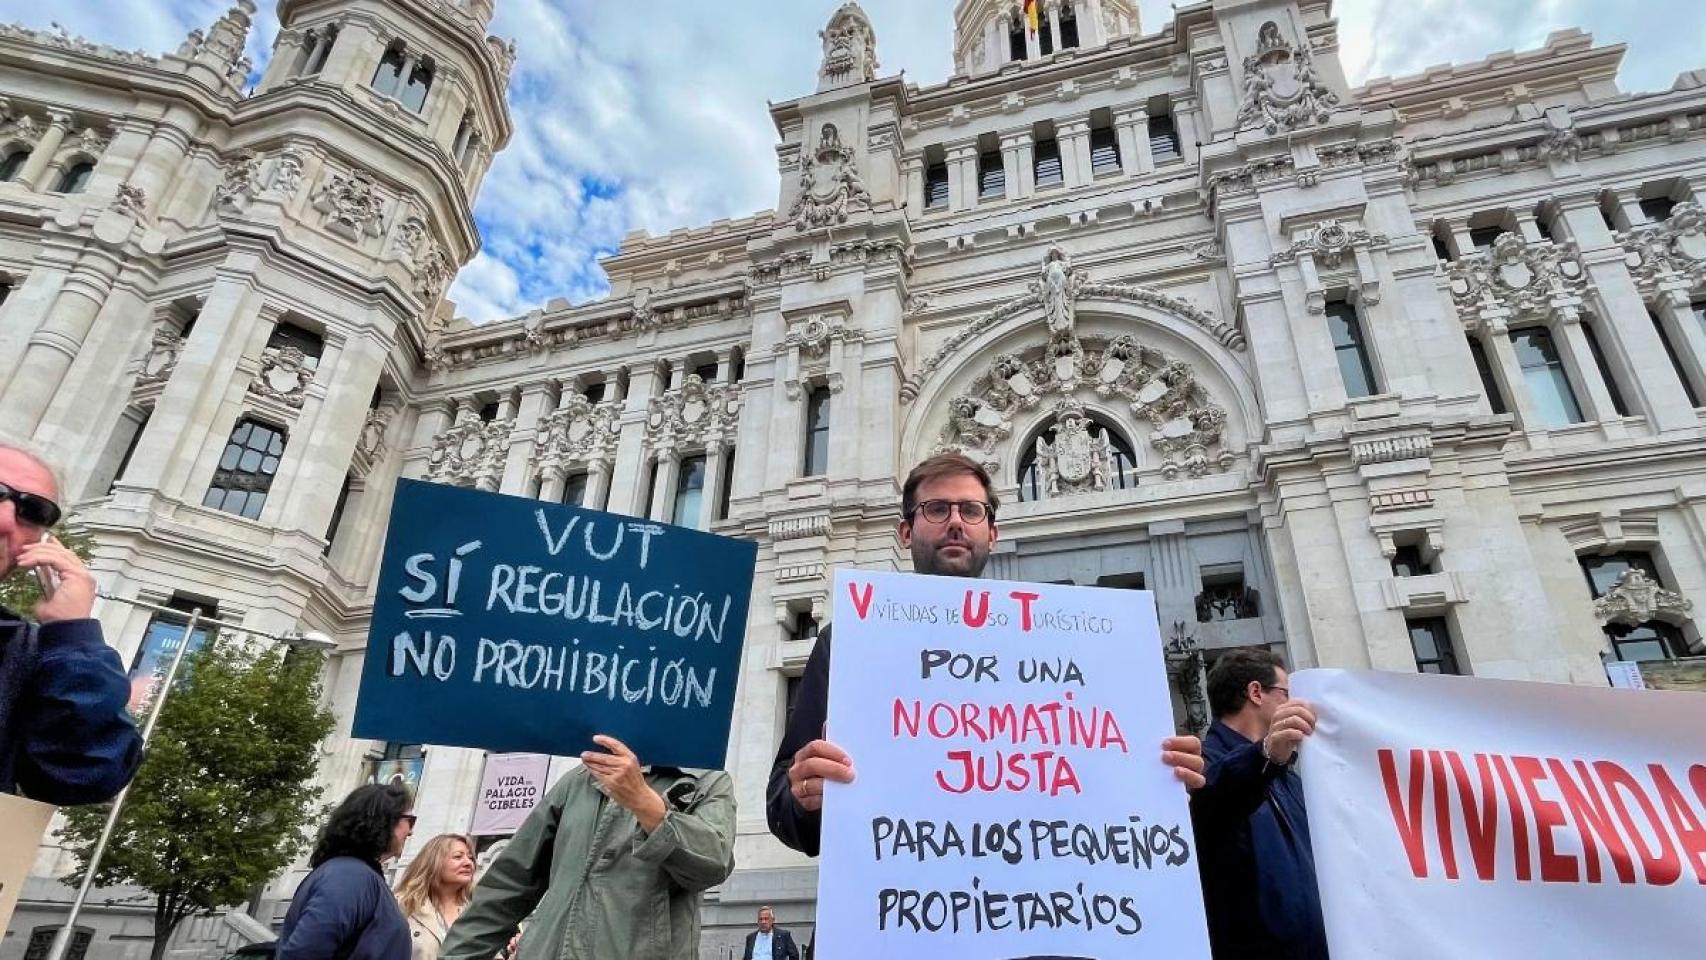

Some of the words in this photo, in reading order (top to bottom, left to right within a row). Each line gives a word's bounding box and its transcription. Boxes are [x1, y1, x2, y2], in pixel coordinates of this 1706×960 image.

[535, 507, 665, 569] VUT
[398, 540, 482, 605] SÍ
[486, 564, 732, 644] REGULACIÓN
[963, 590, 1009, 628] USO
[393, 630, 456, 682] NO
[920, 649, 1000, 683] POR
[1018, 657, 1085, 686] UNA
[893, 691, 1128, 752] NORMATIVA
[485, 786, 537, 799] PALACIO
[497, 775, 525, 787] VIDA
[935, 751, 1081, 796] JUSTA
[489, 798, 534, 810] CIBELES
[1377, 748, 1706, 886] VIVIENDA
[872, 816, 966, 862] PARA
[971, 819, 1023, 864] LOS
[1029, 815, 1190, 870] PEQUEÑOS
[878, 876, 1142, 935] PROPIETARIOS
